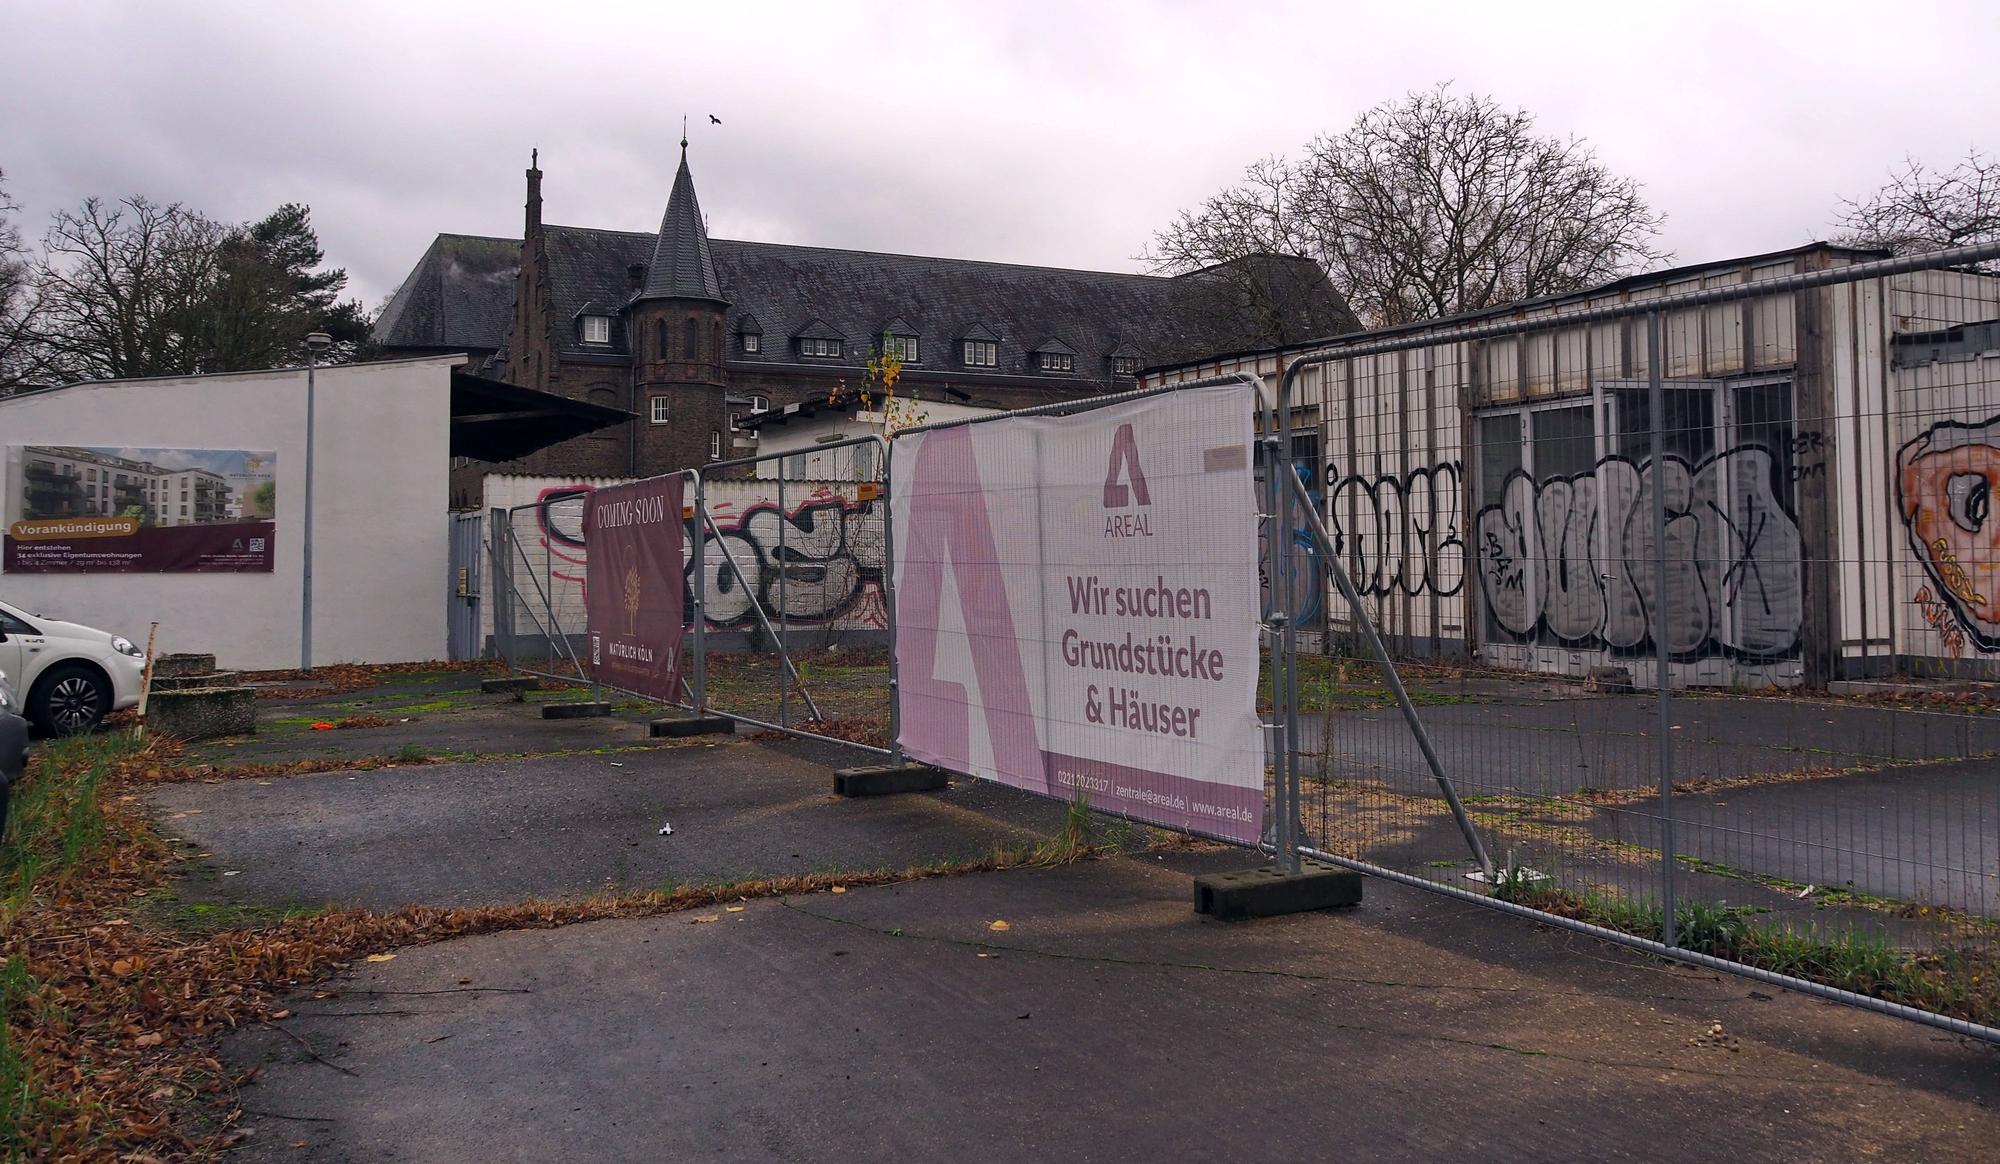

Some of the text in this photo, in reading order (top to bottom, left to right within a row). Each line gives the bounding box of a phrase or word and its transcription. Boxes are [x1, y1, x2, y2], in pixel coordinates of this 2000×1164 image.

[18, 522, 131, 535] Vorankündigung
[597, 500, 633, 529] COMING
[635, 495, 664, 525] SOON
[1104, 513, 1153, 538] AREAL
[1066, 575, 1211, 619] Wir suchen
[609, 640, 653, 663] NATÜRLICH KÖLN
[1062, 628, 1224, 681] Grundstücke
[1085, 684, 1200, 738] & Häuser
[1116, 785, 1184, 809] zentrale@areal.de
[1192, 801, 1252, 822] www.areal.de
